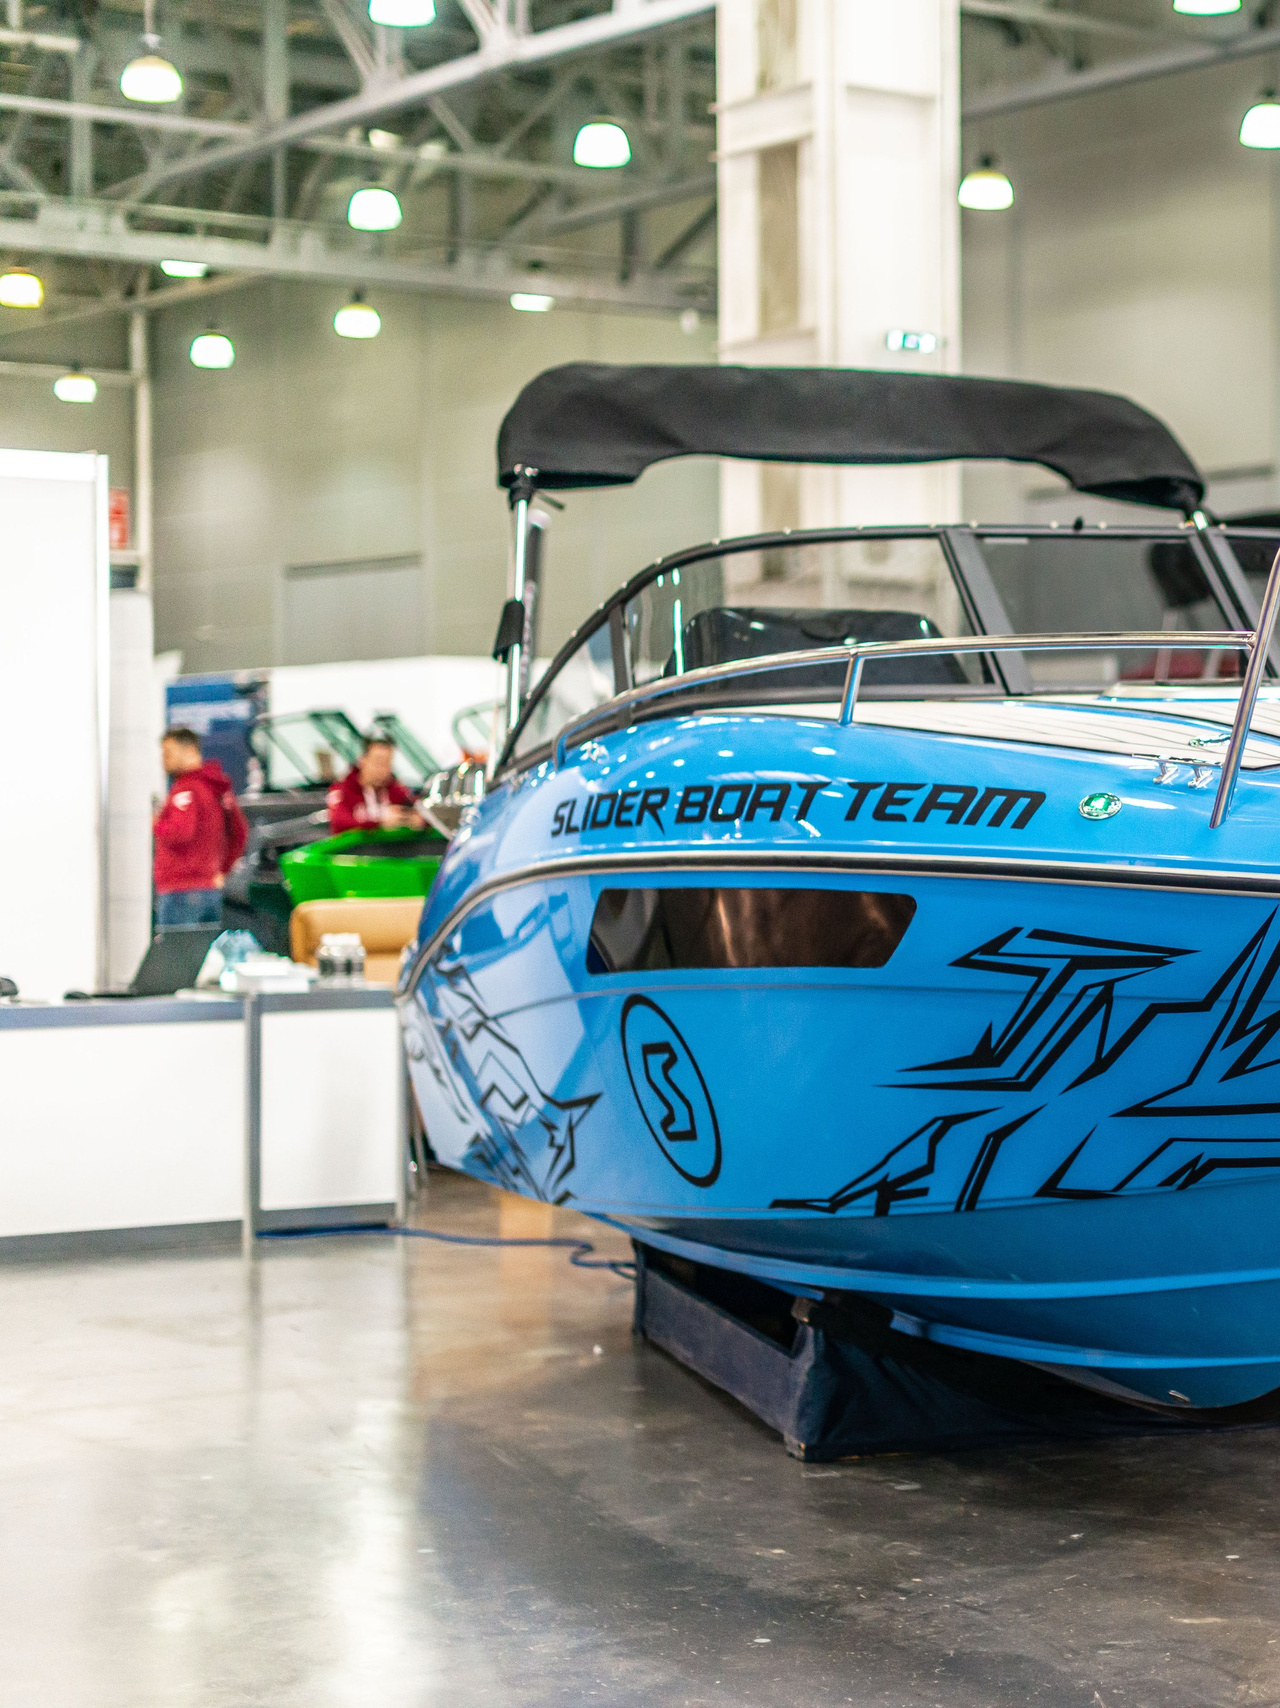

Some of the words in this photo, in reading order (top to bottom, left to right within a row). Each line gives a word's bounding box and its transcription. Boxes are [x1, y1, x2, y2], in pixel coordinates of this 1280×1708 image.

[551, 786, 669, 837] SLIDER
[674, 781, 832, 825] BOAT
[844, 781, 1048, 831] TEAM
